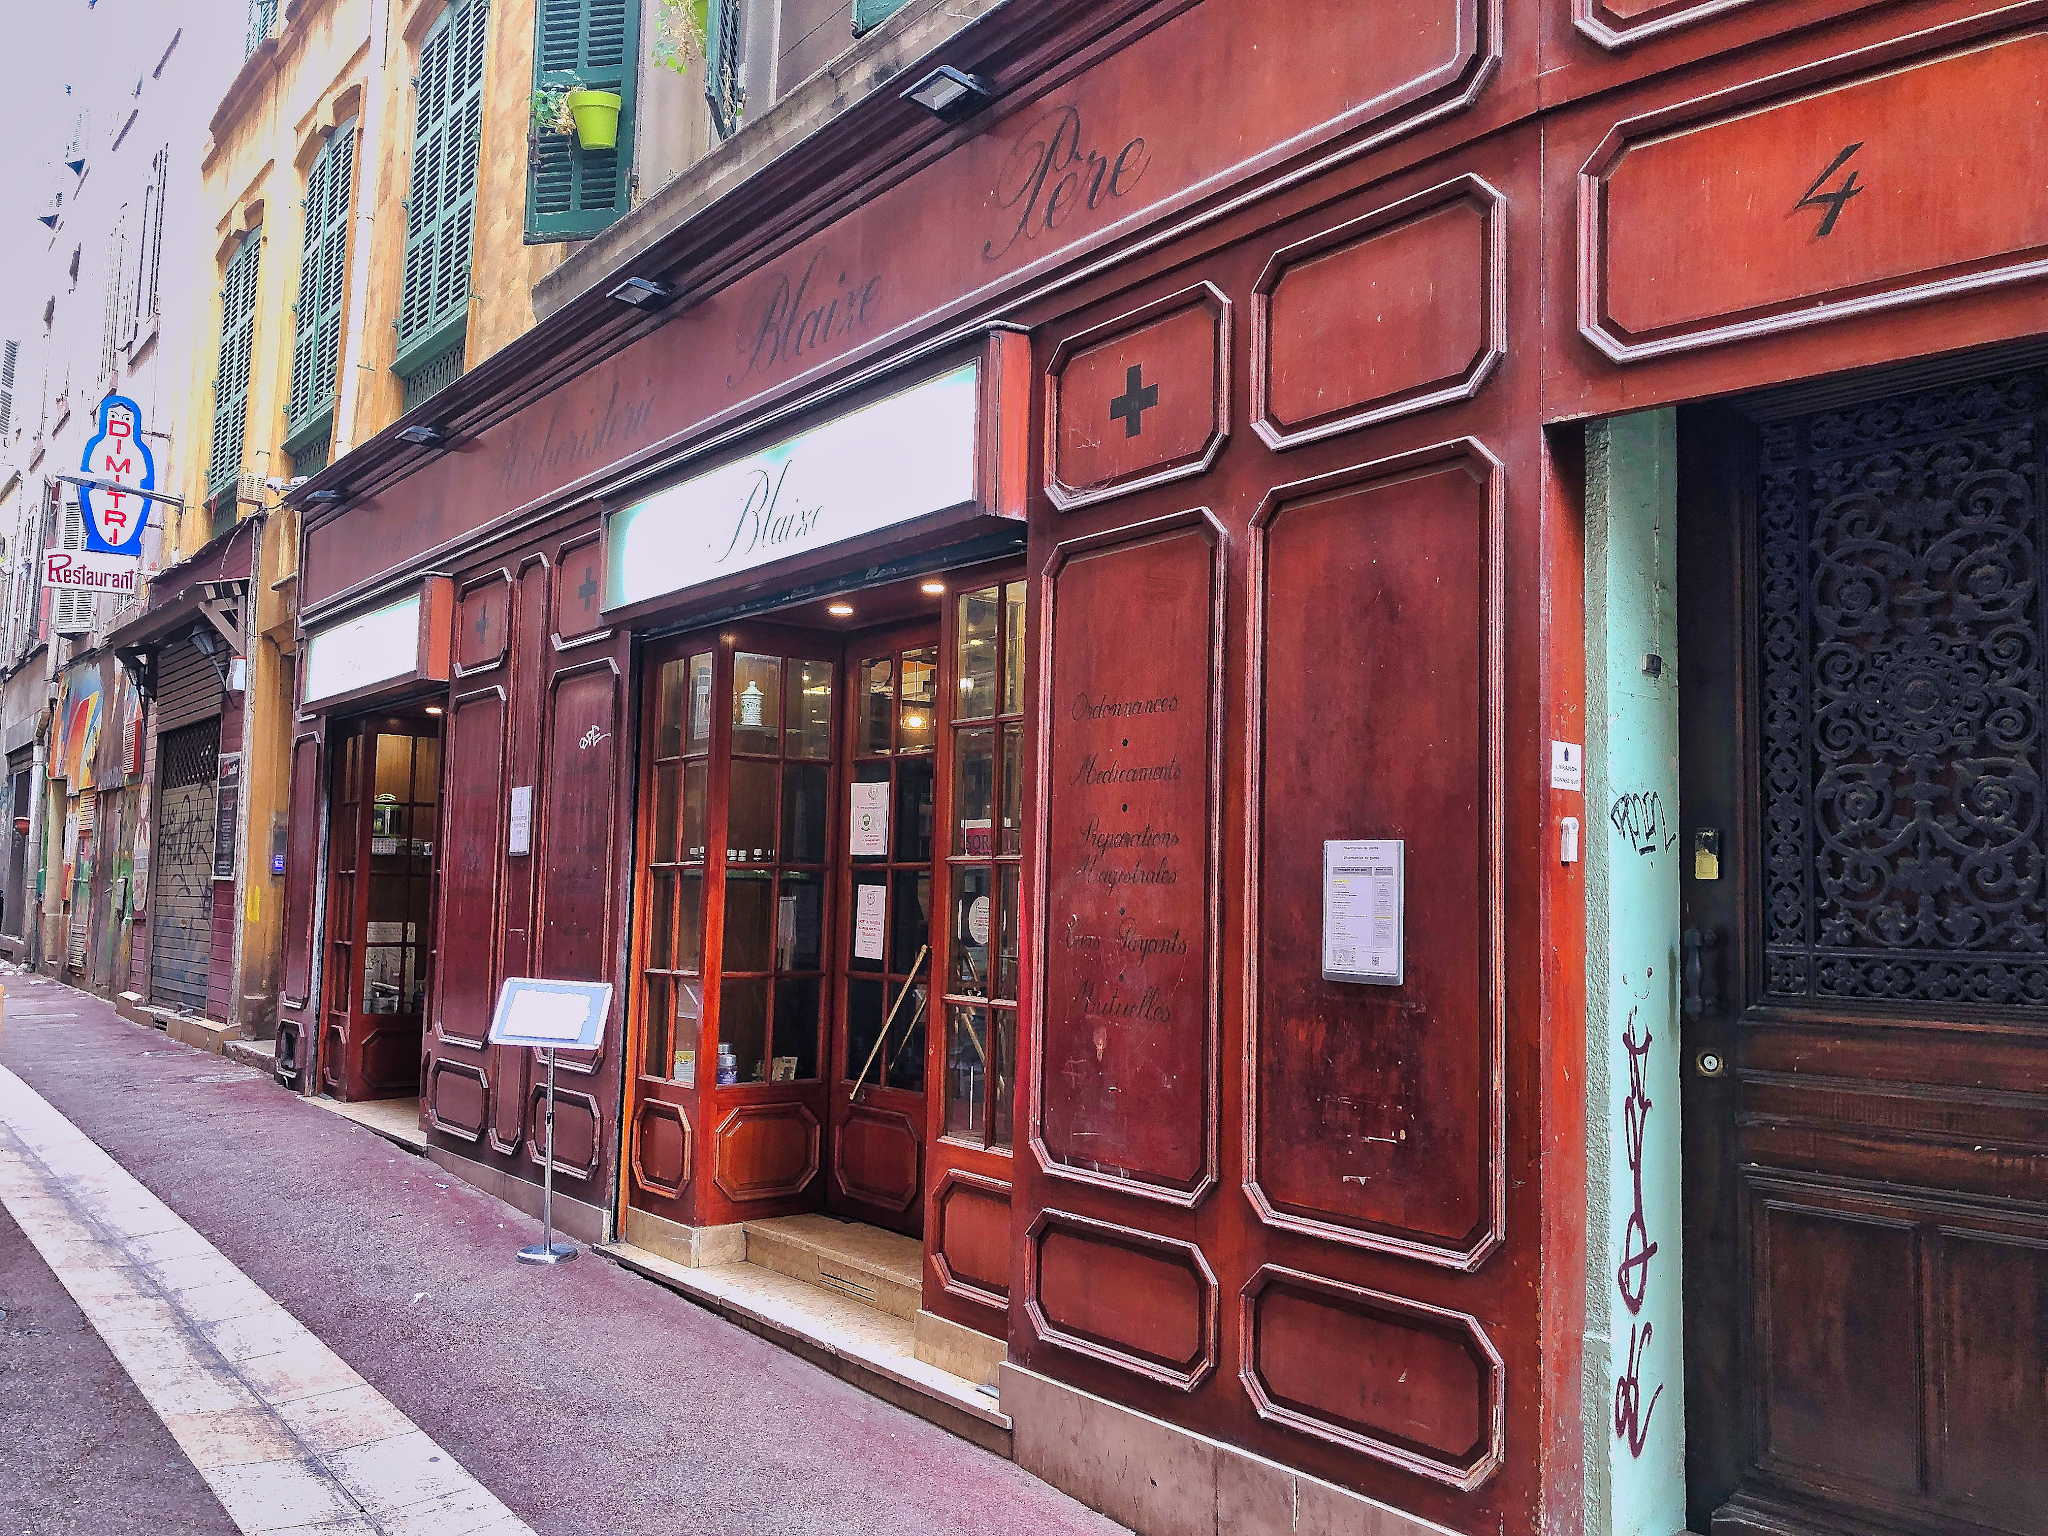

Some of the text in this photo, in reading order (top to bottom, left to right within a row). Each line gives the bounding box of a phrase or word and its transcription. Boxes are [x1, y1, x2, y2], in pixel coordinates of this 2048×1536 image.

[982, 104, 1152, 261] Père
[1792, 141, 1866, 238] 4
[47, 554, 135, 590] Restaurant
[1071, 691, 1179, 721] Ordonnances
[1119, 916, 1187, 966] Payants
[1072, 979, 1172, 1023] Mutuelles
